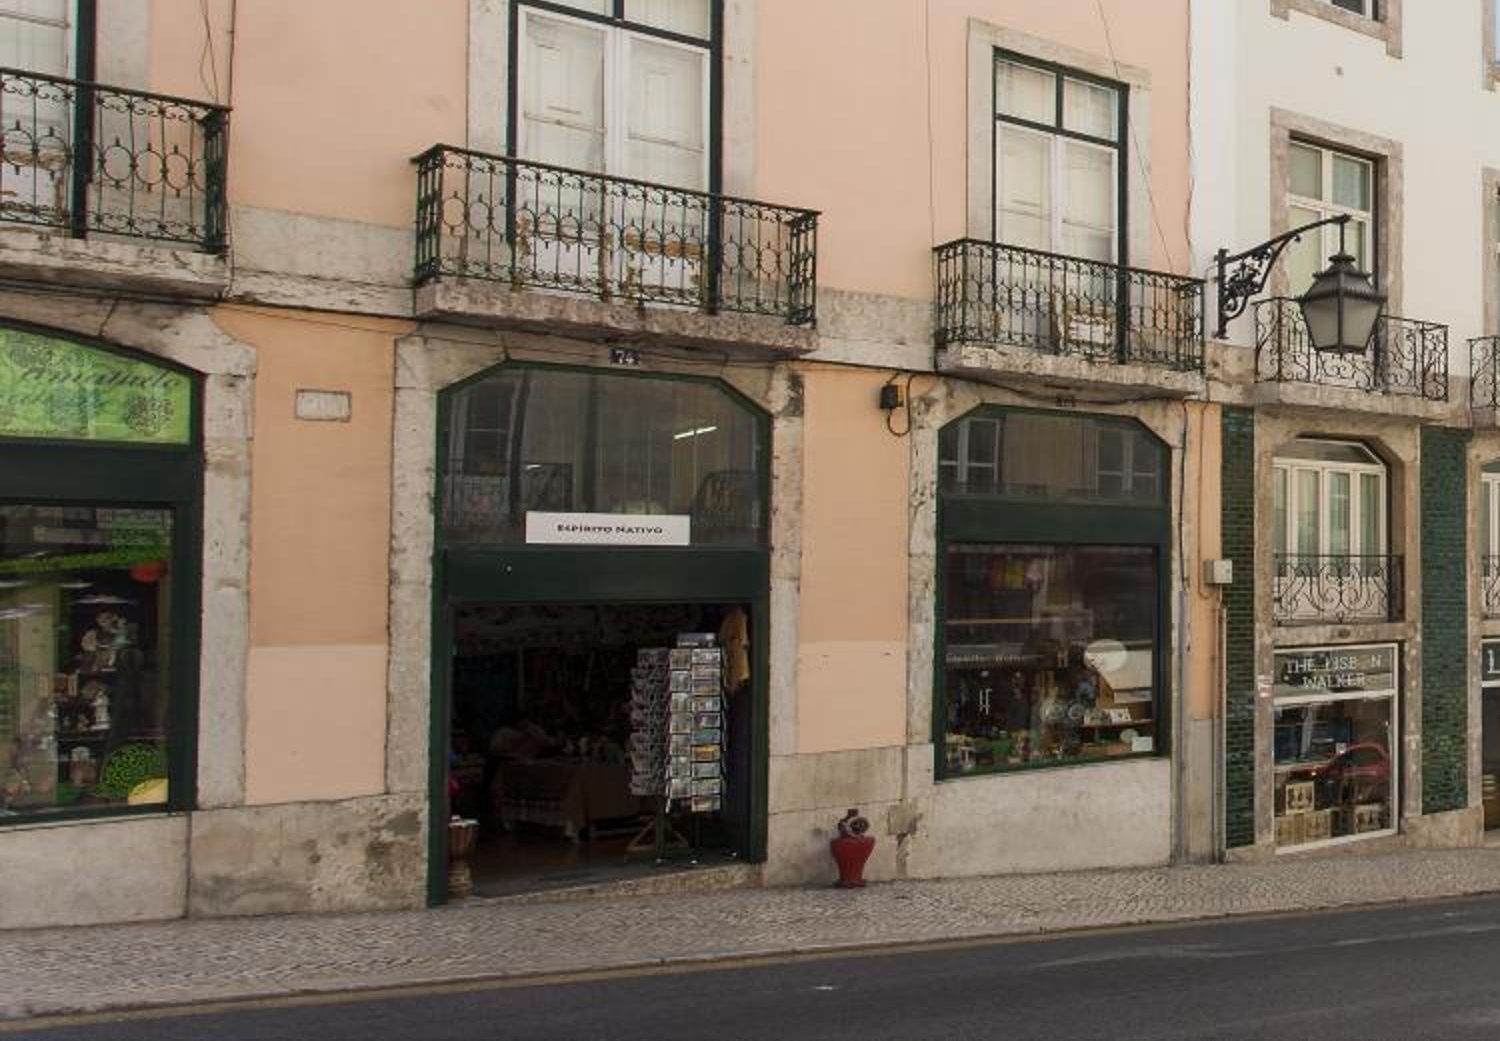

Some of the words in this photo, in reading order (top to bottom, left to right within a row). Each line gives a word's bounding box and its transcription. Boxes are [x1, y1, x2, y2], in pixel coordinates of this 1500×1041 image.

[616, 526, 663, 535] NATIVO
[1286, 657, 1316, 674] THE
[1325, 654, 1381, 672] LISBN
[1302, 672, 1366, 689] WALKER
